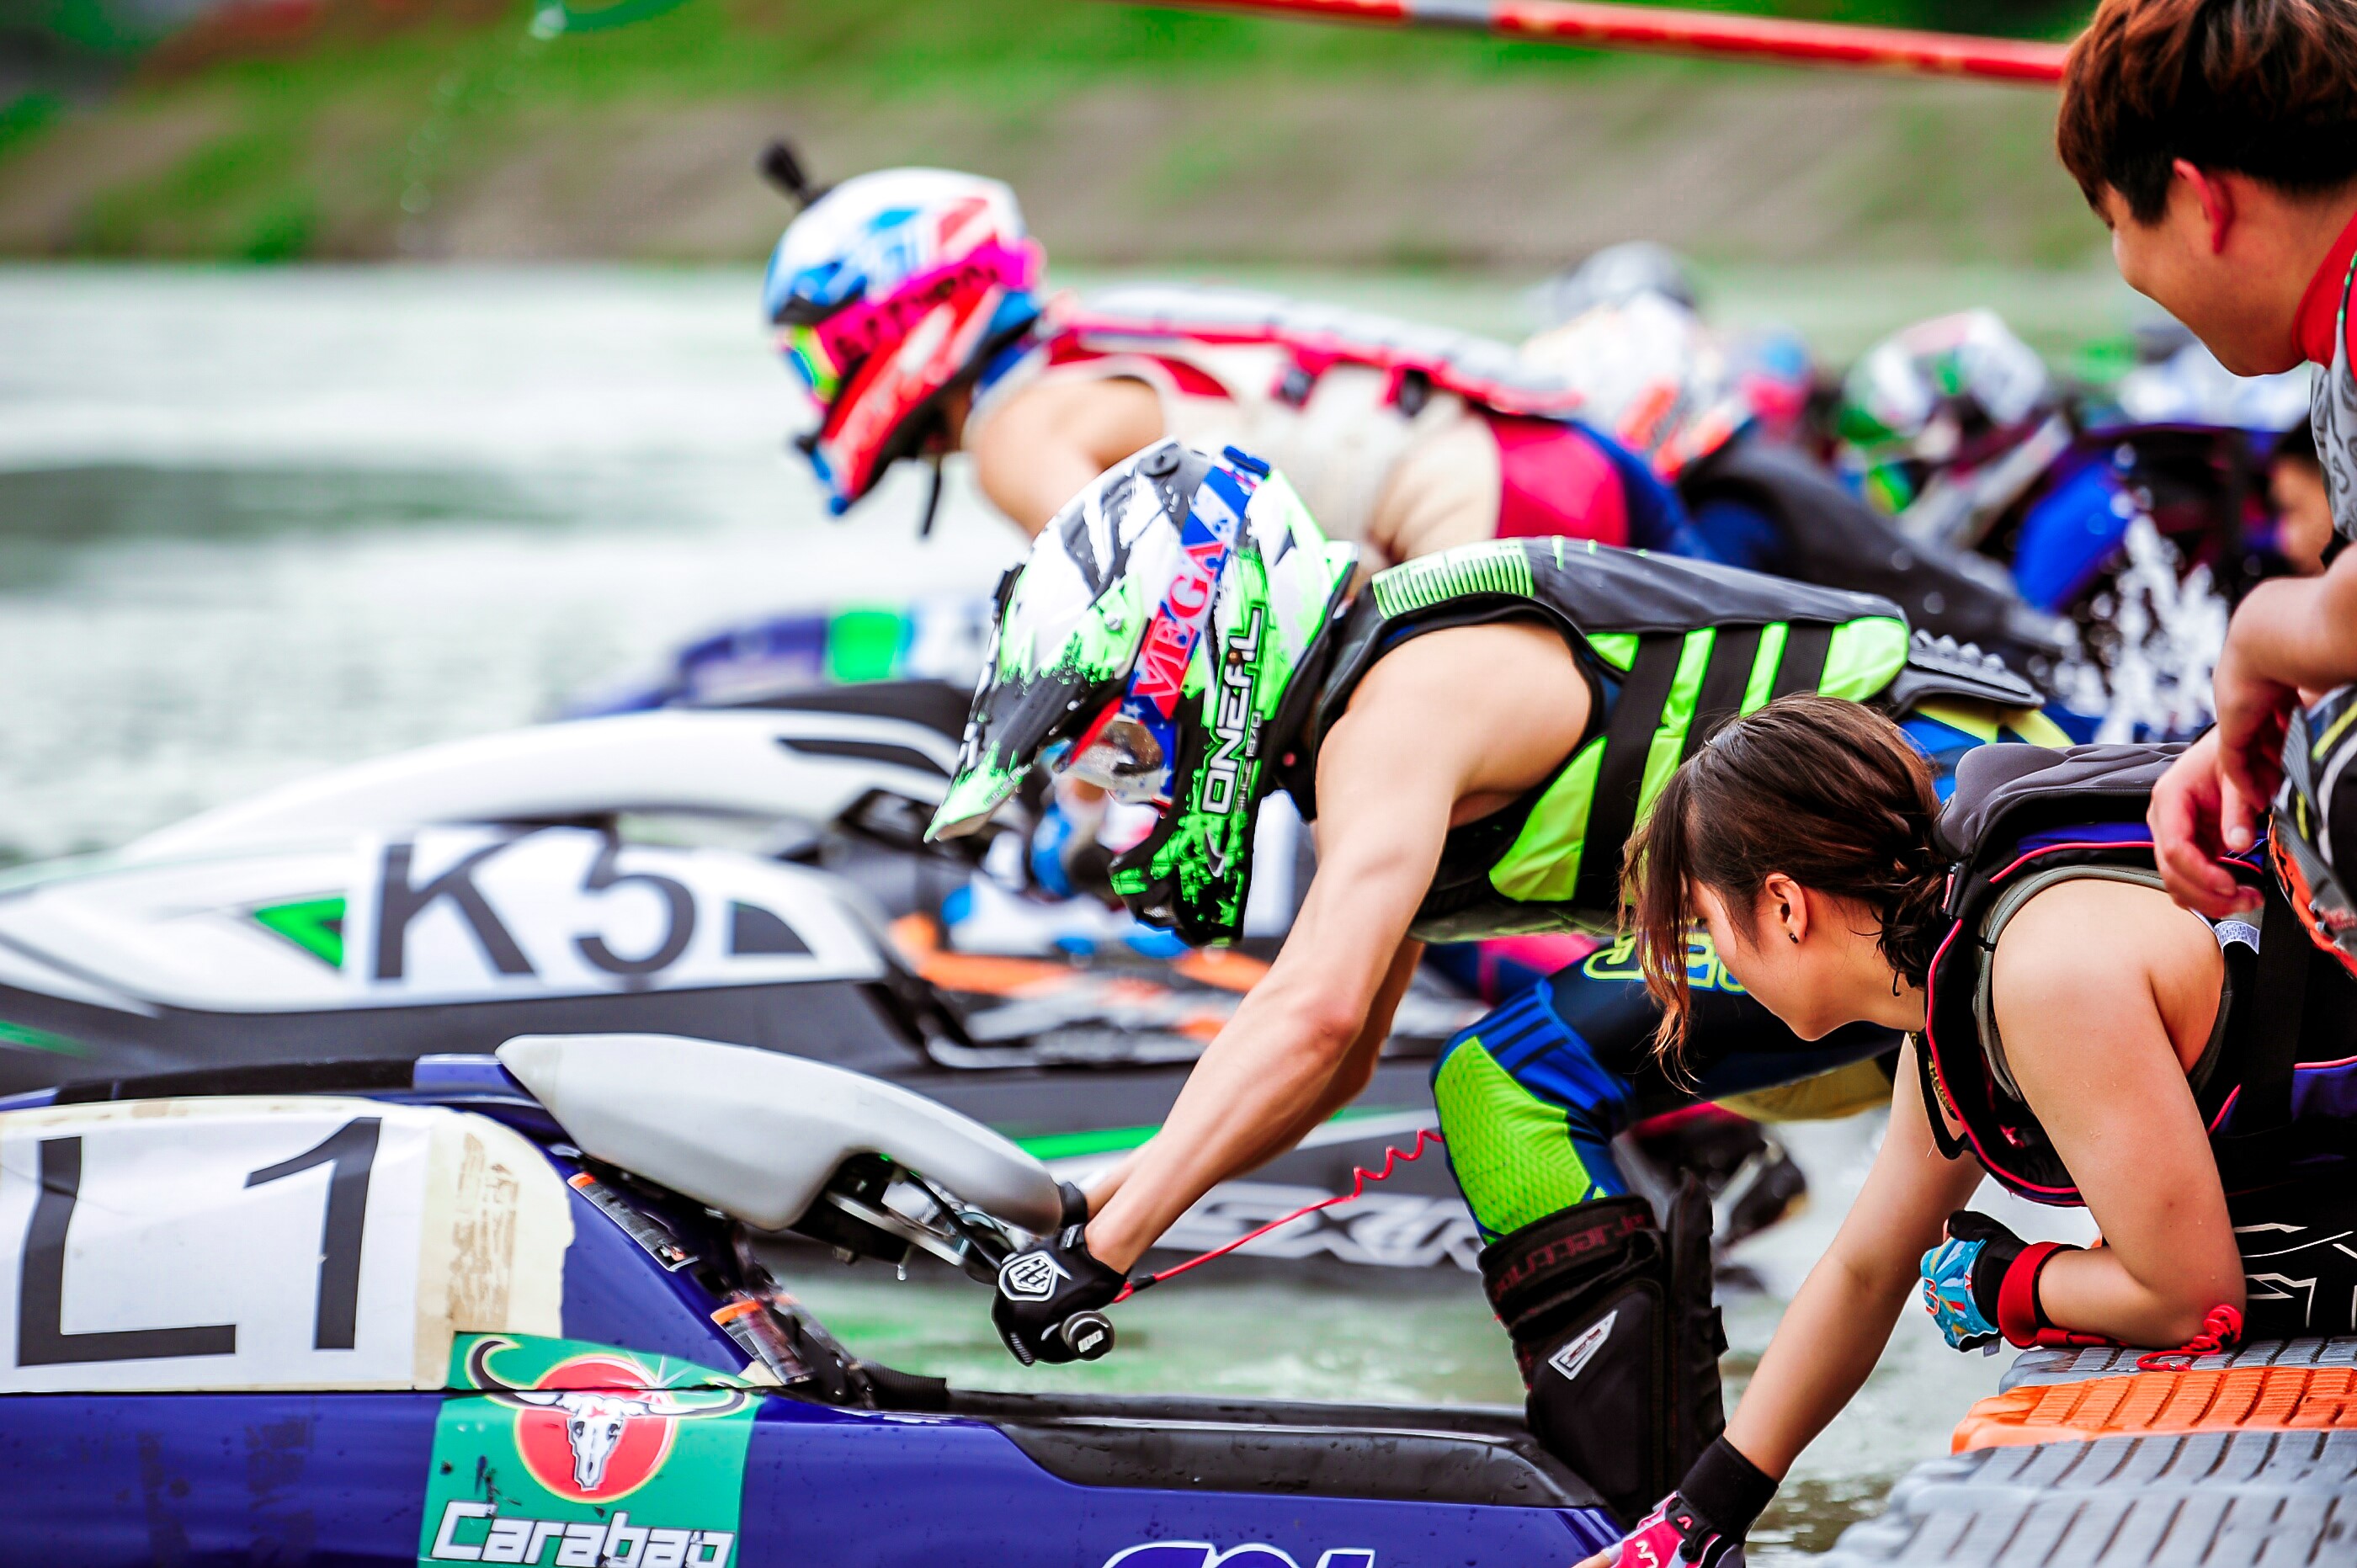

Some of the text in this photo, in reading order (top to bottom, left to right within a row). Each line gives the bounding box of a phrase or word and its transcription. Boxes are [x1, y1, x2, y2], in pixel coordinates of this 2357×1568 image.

[1132, 542, 1225, 702] VEGA
[376, 823, 696, 975] K5
[16, 1116, 383, 1368] L1
[430, 1500, 736, 1568] Carabao
